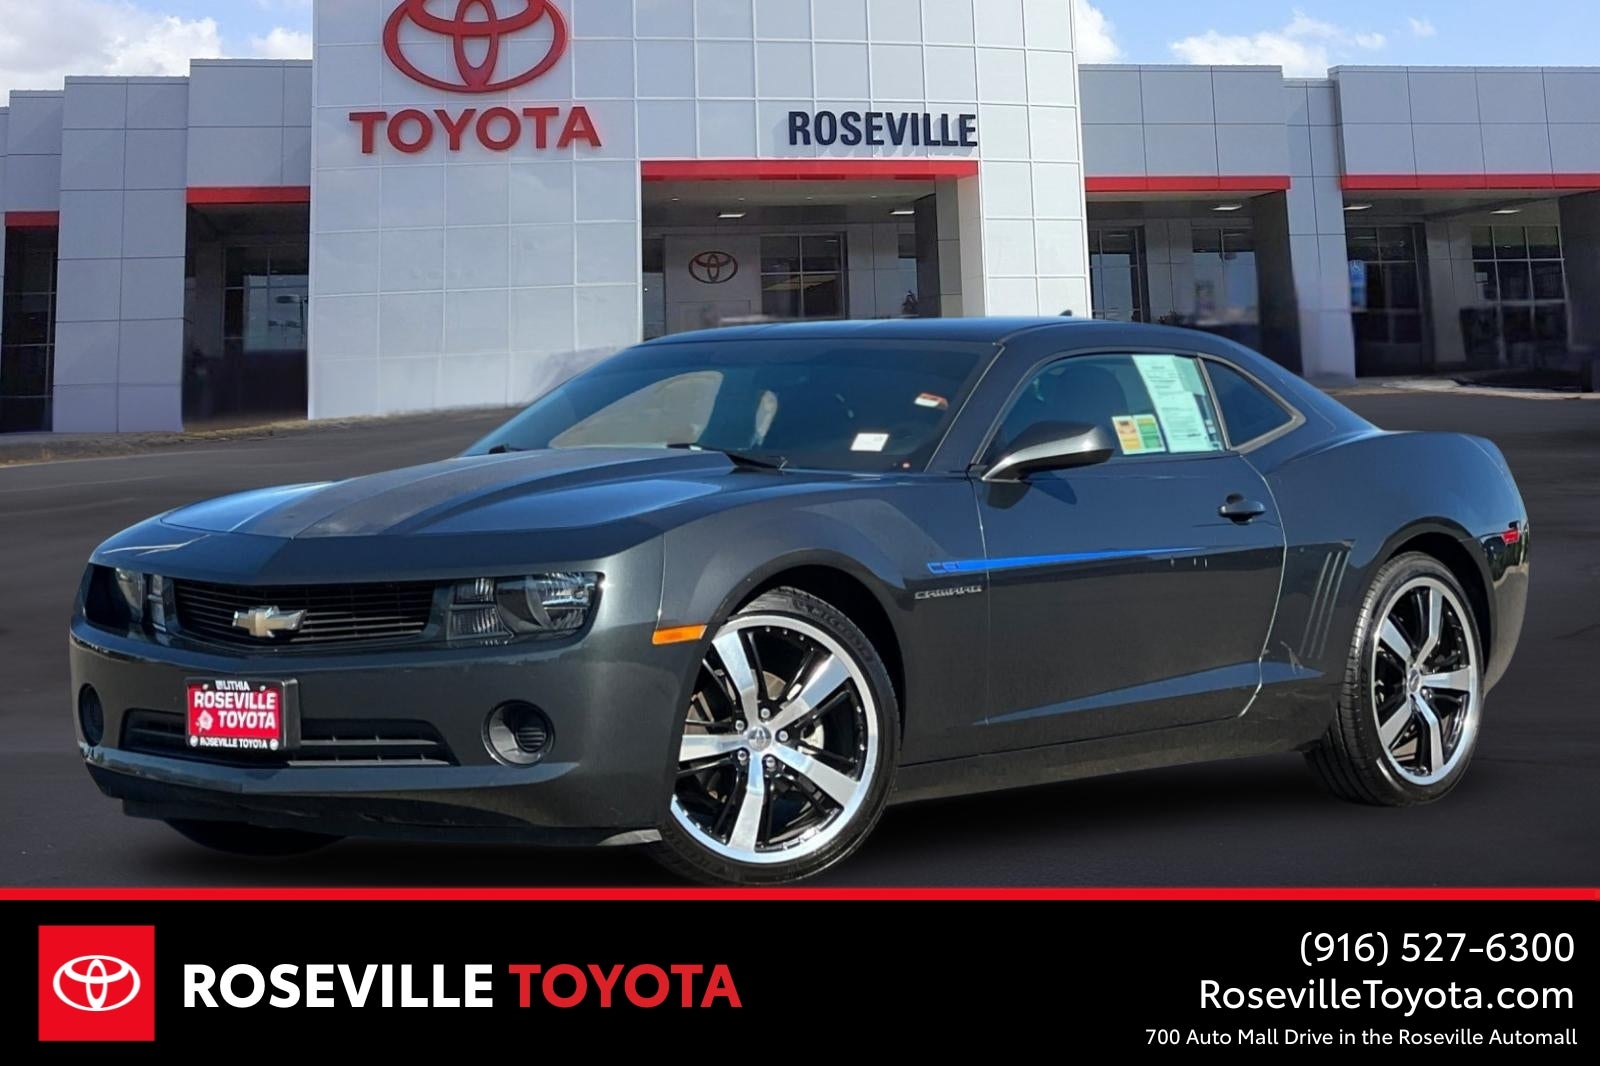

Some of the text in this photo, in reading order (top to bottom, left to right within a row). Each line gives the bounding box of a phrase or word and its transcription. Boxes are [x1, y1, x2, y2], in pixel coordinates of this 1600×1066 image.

[349, 106, 602, 154] TOYOTA
[788, 110, 978, 147] ROSEVILLE
[223, 680, 250, 690] LITHIA
[194, 691, 277, 710] ROSEVILLE
[217, 711, 276, 729] TOYOTA
[200, 736, 268, 749] ROSEVILLE TOYOTA
